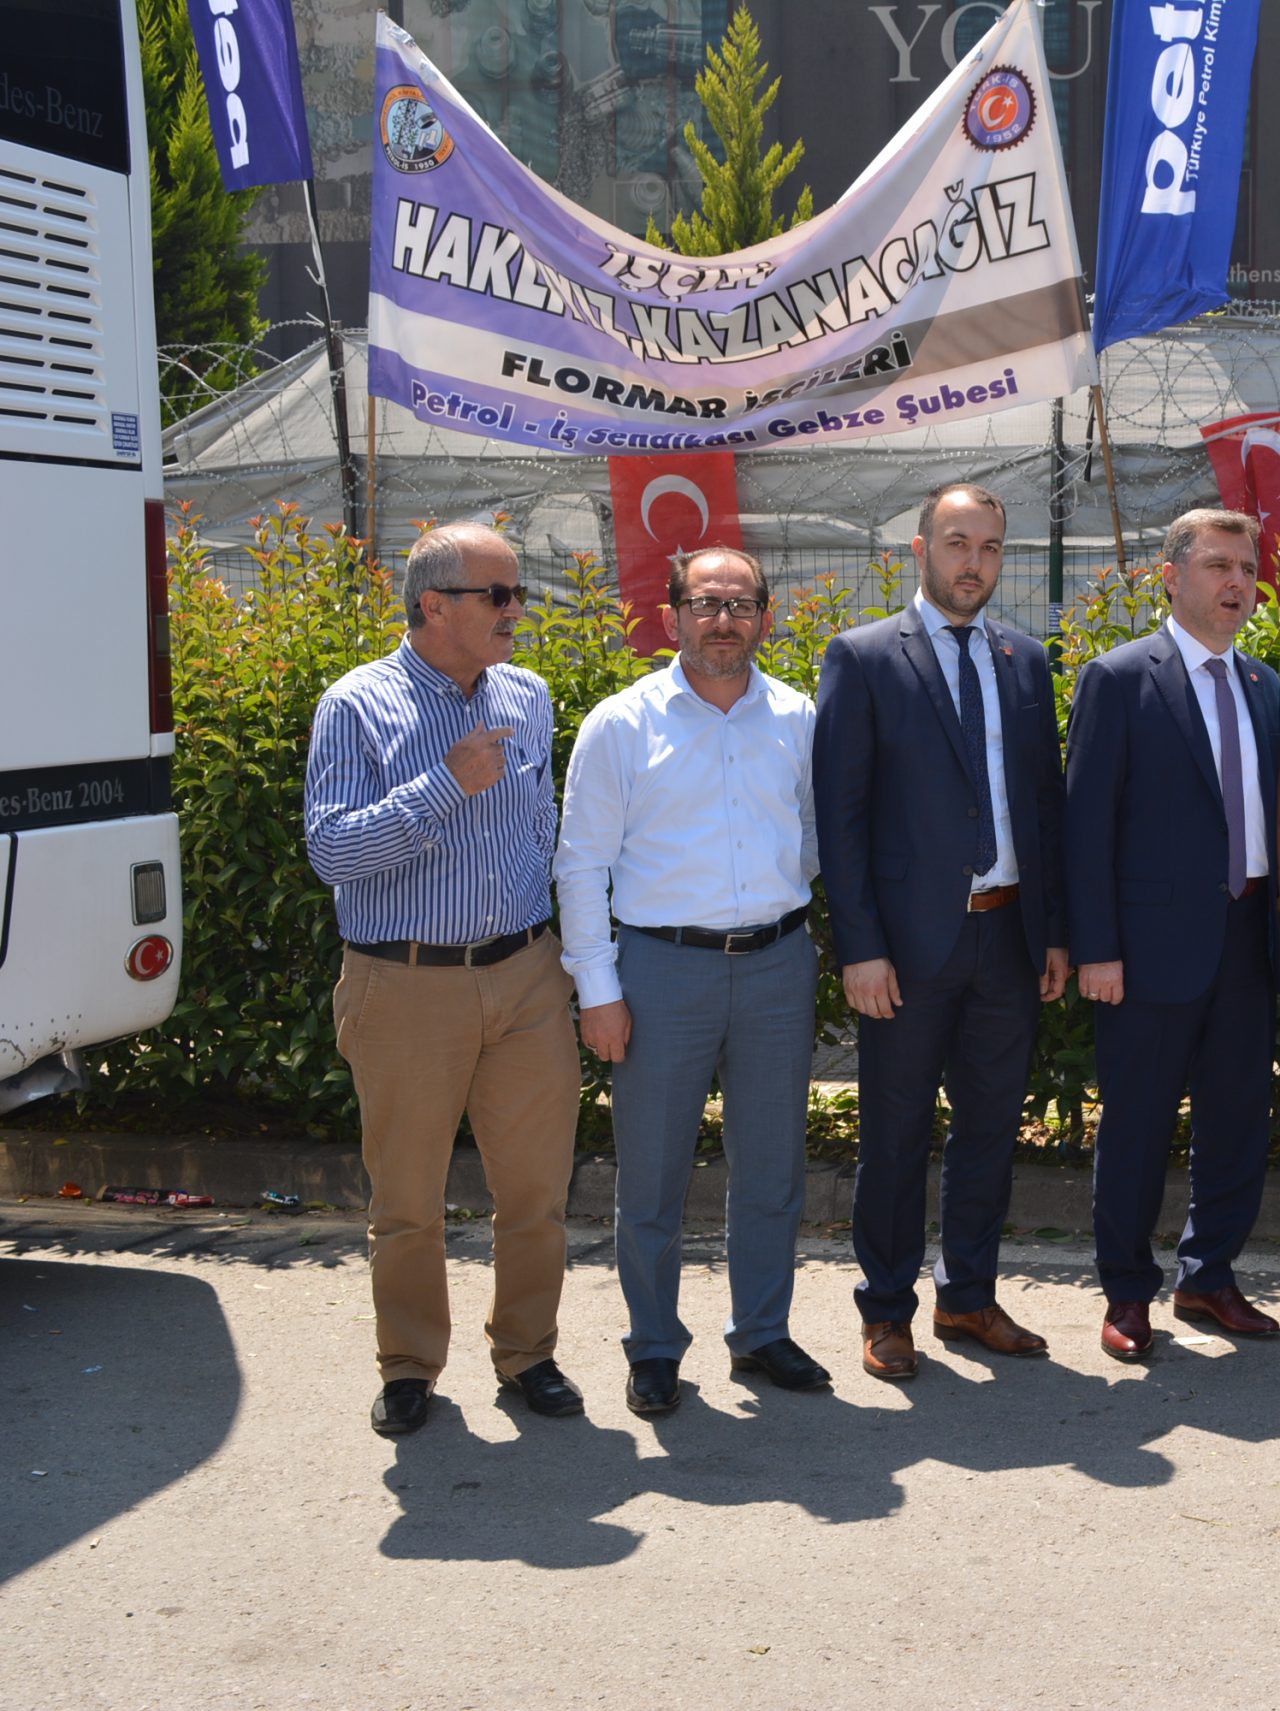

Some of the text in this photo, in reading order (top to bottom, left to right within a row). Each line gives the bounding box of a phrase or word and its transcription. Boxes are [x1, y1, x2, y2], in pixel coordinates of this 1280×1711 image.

[1141, 0, 1206, 215] pet
[1186, 0, 1227, 182] Türkiye Petrol Kim
[411, 379, 517, 431] Petrol
[767, 410, 885, 438] Gebze
[896, 368, 1019, 425] Şubesi
[501, 350, 728, 418] FLORMAR
[78, 776, 125, 808] 2004
